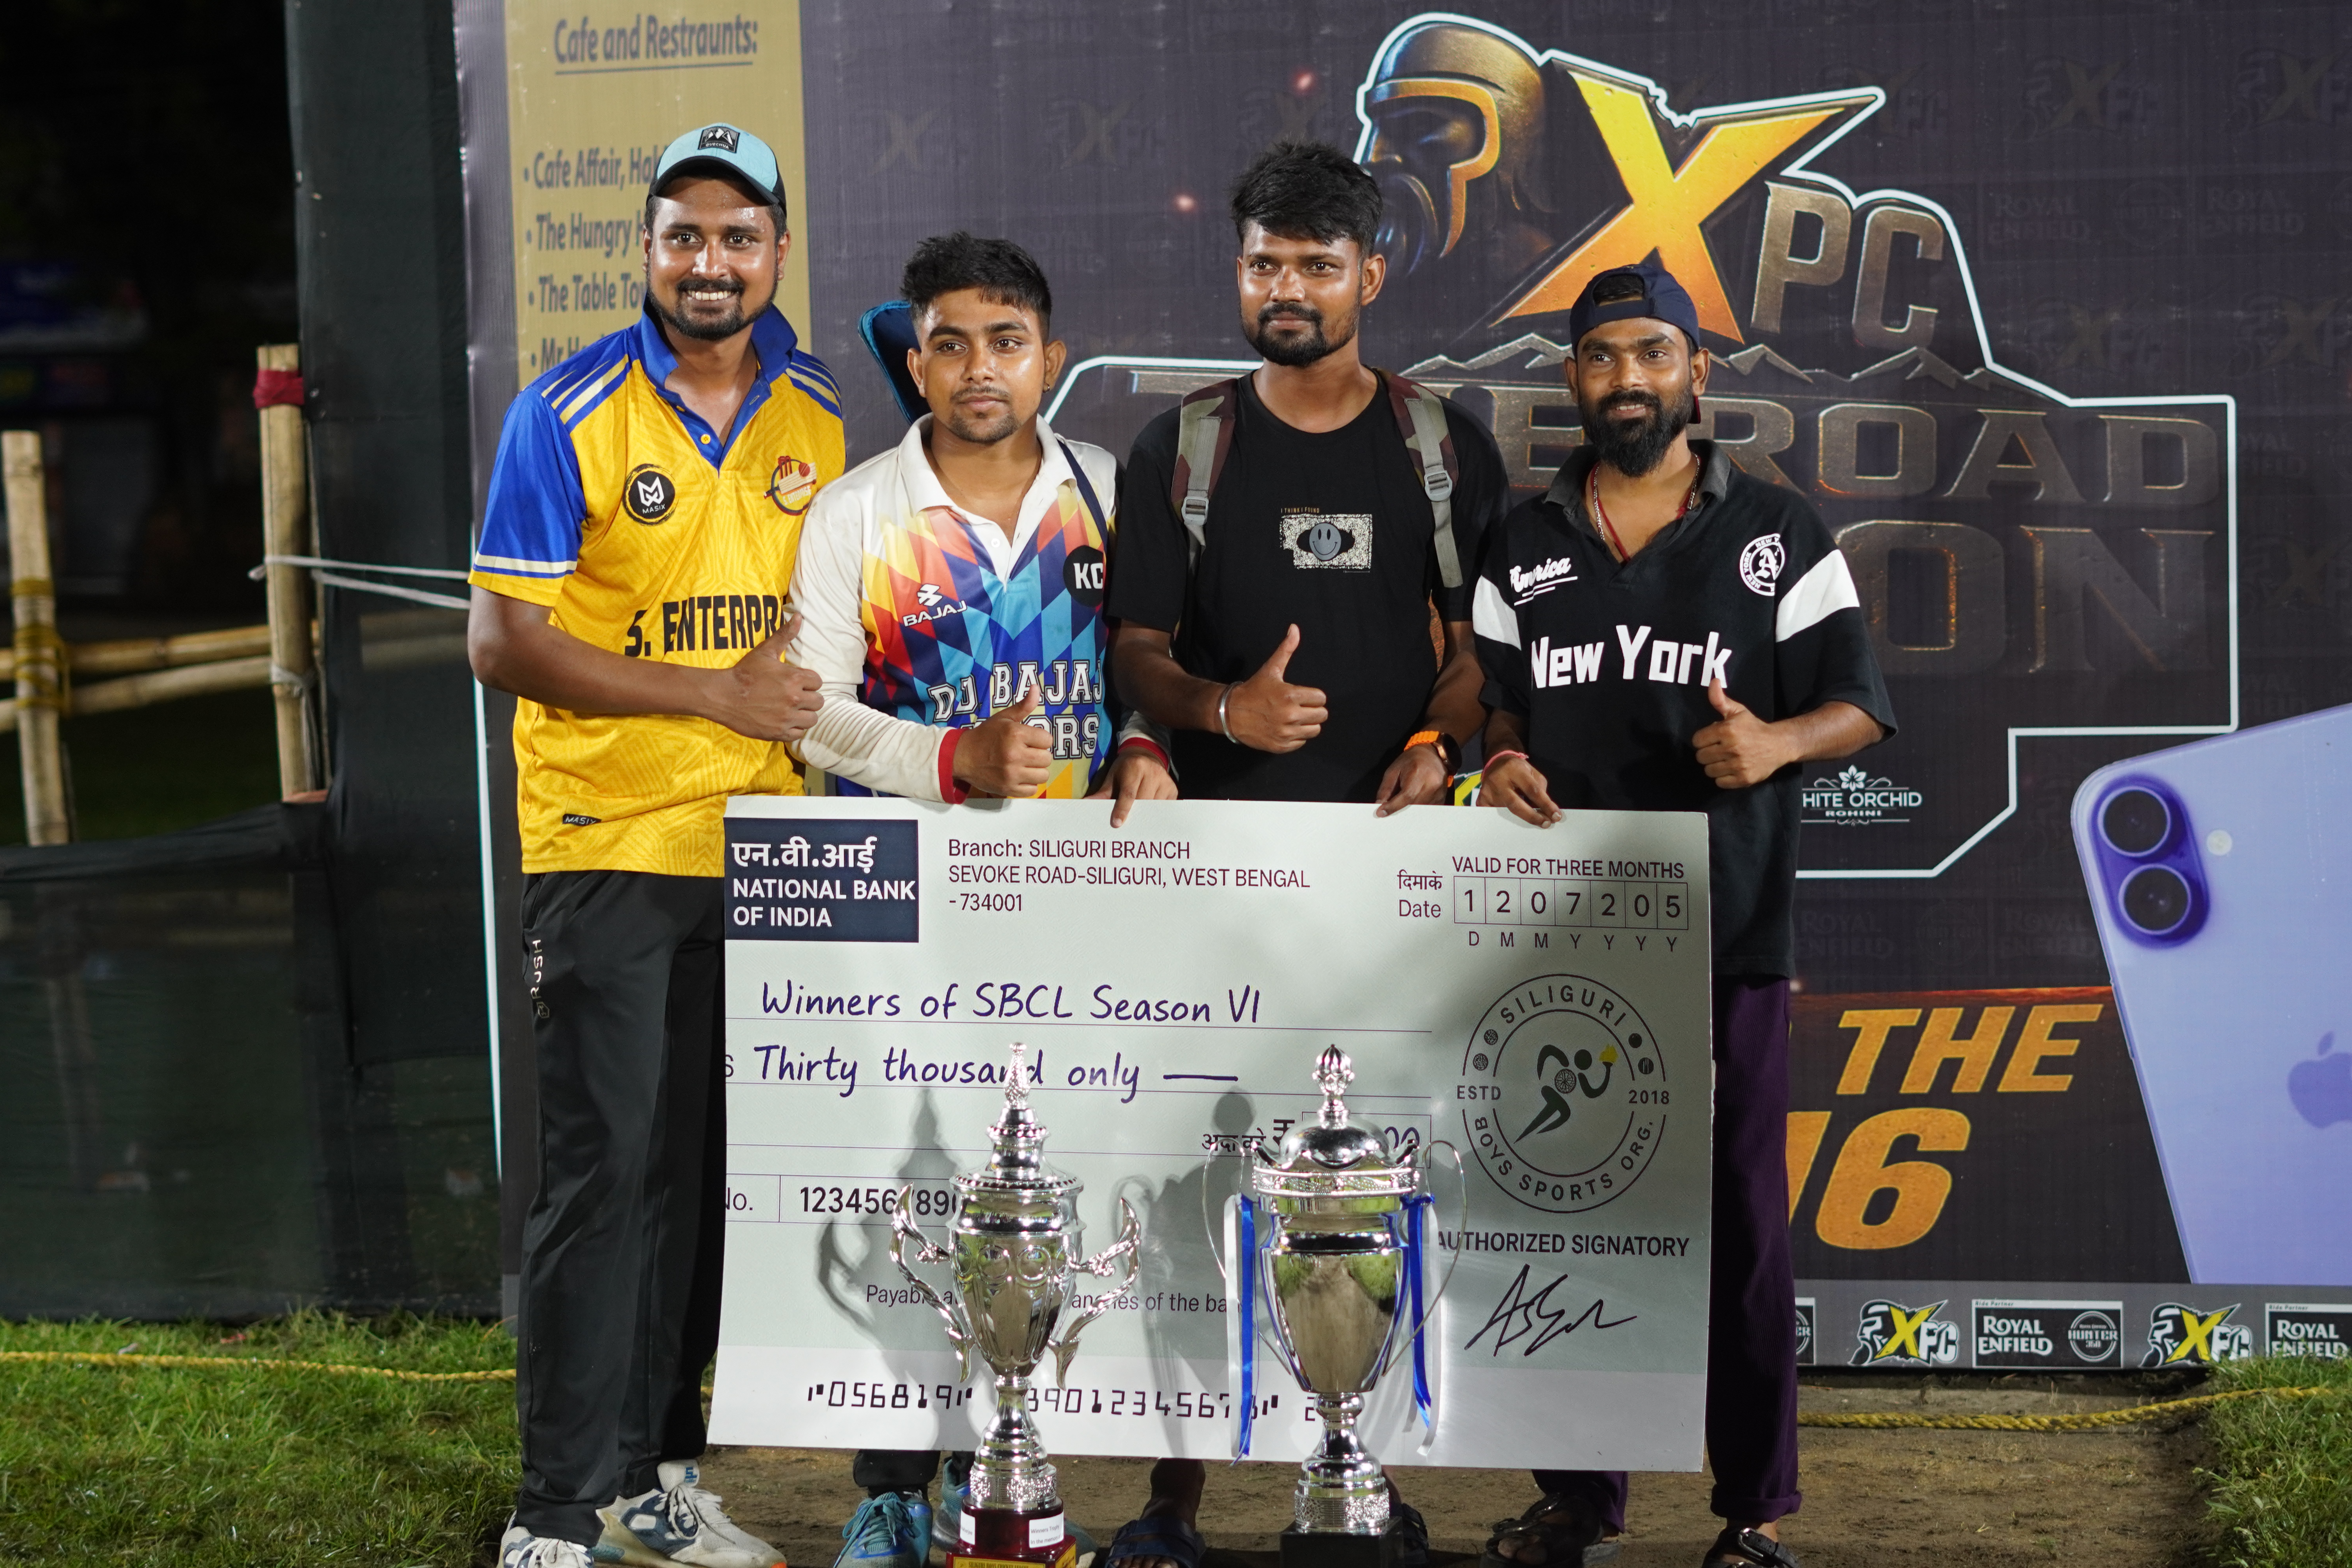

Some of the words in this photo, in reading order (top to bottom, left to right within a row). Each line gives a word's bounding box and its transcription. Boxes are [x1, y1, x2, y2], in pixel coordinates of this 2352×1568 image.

[555, 17, 598, 63] Cafe
[603, 15, 640, 59] and
[646, 15, 759, 58] Restraunts:
[534, 149, 572, 189] Cafe
[574, 147, 625, 191] Affair,
[536, 212, 566, 251] The
[570, 212, 632, 258] Hungry
[538, 274, 568, 312] The
[572, 272, 616, 311] Table
[642, 503, 666, 514] MASIX
[1834, 520, 2217, 674] ON
[624, 609, 652, 657] S.
[662, 594, 785, 652] ENTERPR
[903, 600, 967, 627] BAJAJ
[1531, 636, 1604, 689] New
[1615, 624, 1732, 689] York
[927, 672, 978, 723] DJ
[991, 659, 1103, 709] BAJAJ
[1802, 792, 1843, 808] HITE
[1849, 792, 1923, 808] ORCHID
[948, 838, 1023, 857] Branch:
[1029, 839, 1106, 858] SILIGURI
[1111, 840, 1191, 860] BRANCH
[948, 865, 1020, 884] SEVOKE
[1026, 866, 1167, 889] ROAD-SILIGURI,
[1172, 867, 1229, 887] WEST
[1235, 869, 1311, 888] BENGAL
[1452, 856, 1501, 874] VALID
[1507, 858, 1541, 875] FOR
[1546, 859, 1603, 877] THREE
[1608, 860, 1684, 879] MONTHS
[733, 878, 847, 899] NATIONAL
[853, 880, 916, 900] BANK
[733, 906, 764, 926] OF
[770, 907, 833, 927] INDIA
[1398, 899, 1441, 918] Date
[762, 979, 901, 1015] Winners
[920, 983, 958, 1019] of
[973, 983, 1073, 1018] SBCL
[1090, 984, 1210, 1022] Season
[1229, 984, 1260, 1023] VI
[1500, 985, 1626, 1026] SILIGURI
[1836, 1004, 2104, 1095] THE
[753, 1045, 858, 1098] Thirty
[1068, 1052, 1140, 1103] only
[1456, 1085, 1501, 1100] ESTD
[1628, 1089, 1670, 1105] 2018
[1474, 1116, 1513, 1176] BOYS
[1519, 1172, 1613, 1201] SPORTS
[1620, 1121, 1654, 1170] ORG.
[800, 1187, 956, 1216] 12345689
[1437, 1231, 1565, 1253] AUTHORIZED
[1571, 1234, 1690, 1257] SIGNATORY
[866, 1284, 925, 1307] Payab
[1145, 1292, 1164, 1310] of
[1169, 1292, 1200, 1312] the
[1983, 1315, 2044, 1336] ROYAL
[2276, 1319, 2340, 1340] ROYAL
[1978, 1337, 2054, 1356] ENFIELD
[2271, 1341, 2350, 1359] ENFIELD
